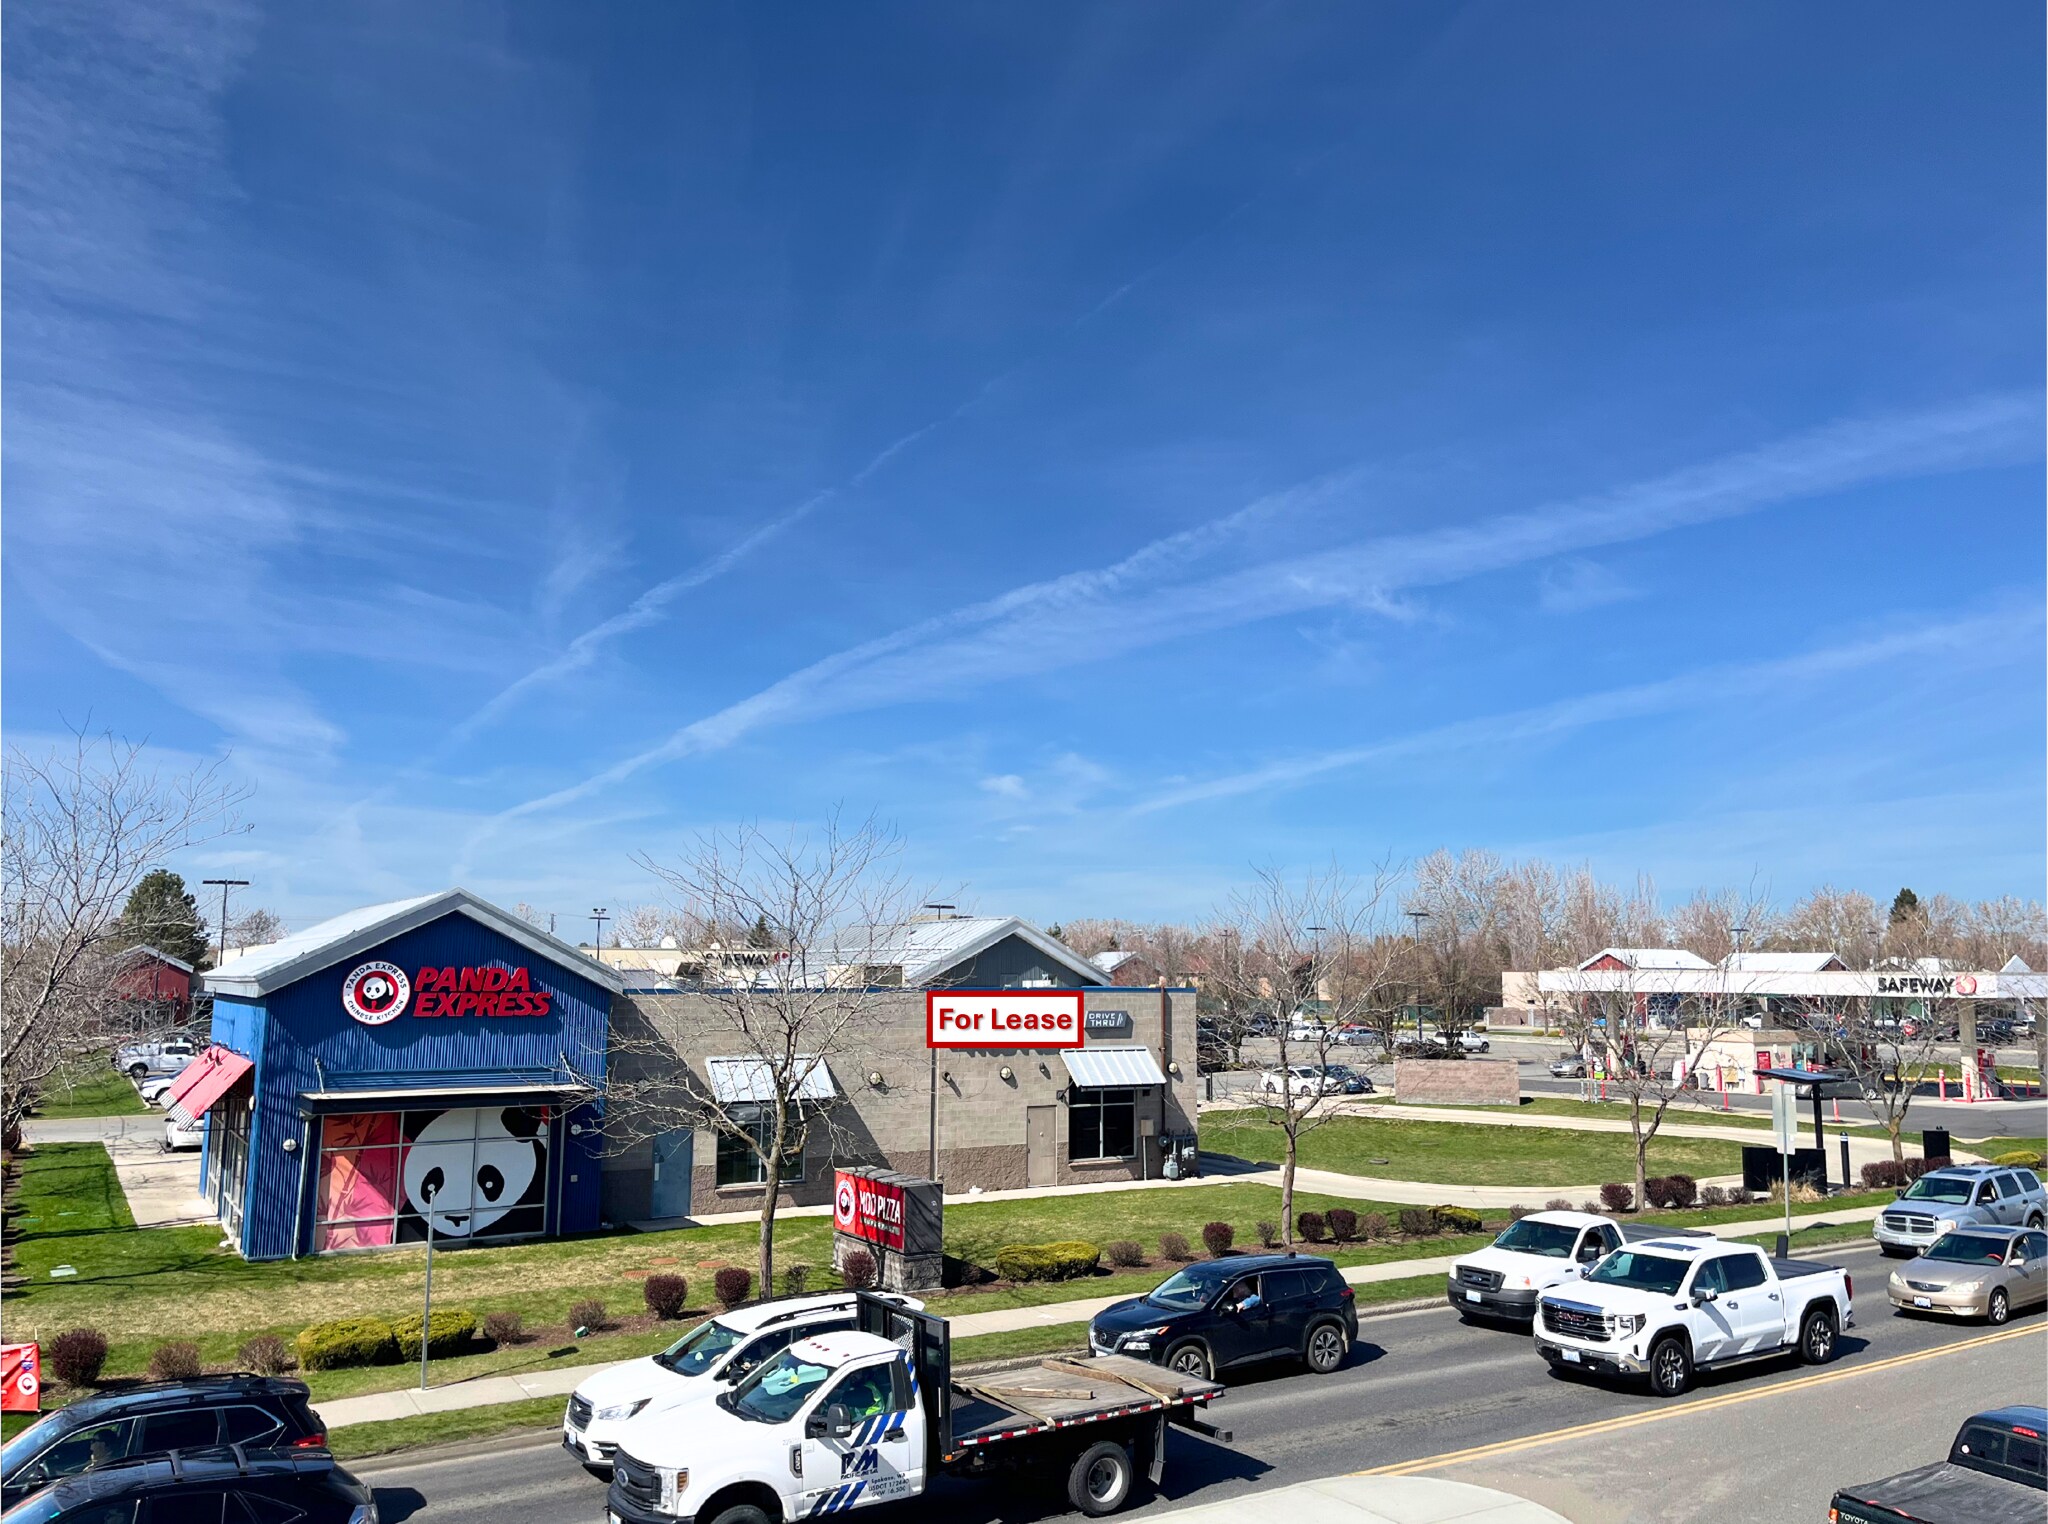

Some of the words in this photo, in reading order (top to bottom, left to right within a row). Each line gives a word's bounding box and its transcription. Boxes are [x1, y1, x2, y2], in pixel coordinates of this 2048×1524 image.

[346, 965, 372, 989] PANDA
[375, 963, 407, 989] EXPRESS
[414, 967, 531, 991] PANDA
[1878, 977, 1955, 993] SAFEWAY
[347, 1000, 373, 1021] CHINESE
[376, 999, 404, 1020] KITCHEN
[413, 992, 552, 1017] EXPRESS
[1089, 1019, 1115, 1027] THRU
[859, 1190, 876, 1216] MOD
[877, 1195, 900, 1224] PIZZA
[1558, 1312, 1585, 1322] GMC
[1840, 1511, 1868, 1524] TOYOTA
